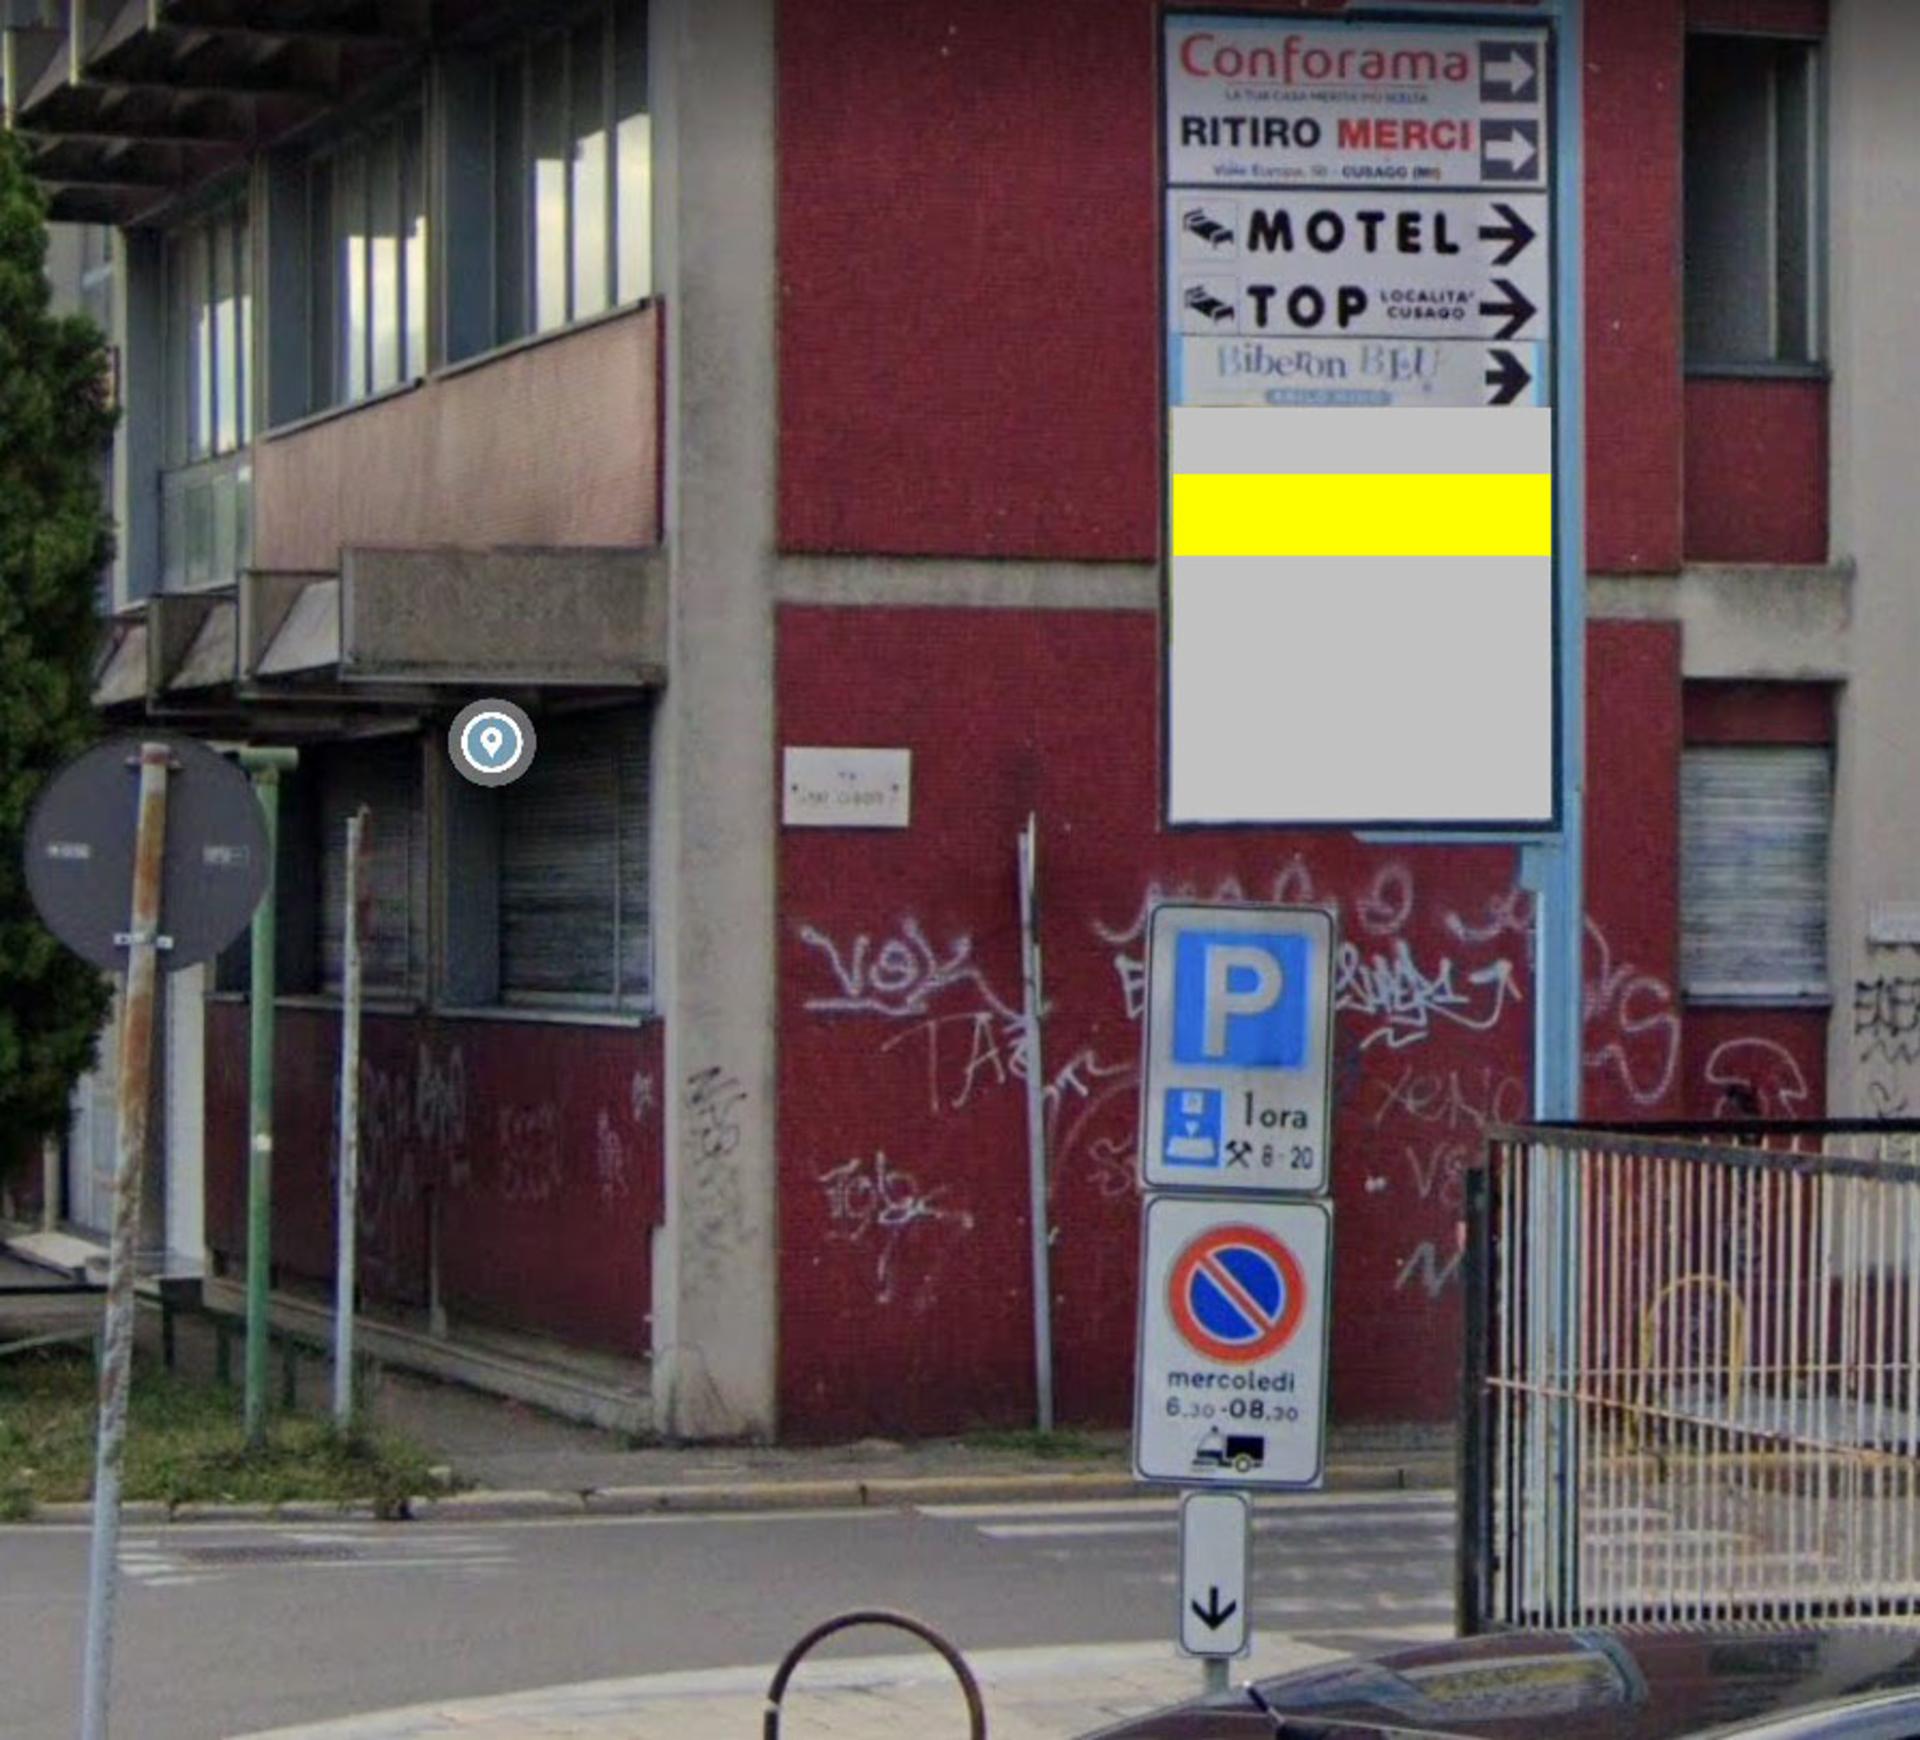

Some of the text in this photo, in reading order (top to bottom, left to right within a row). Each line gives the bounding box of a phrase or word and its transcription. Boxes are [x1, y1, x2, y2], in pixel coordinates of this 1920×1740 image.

[1180, 34, 1469, 84] Conforama
[1180, 115, 1474, 151] RITIRO MERCI
[1246, 209, 1461, 255] MOTEL
[1245, 284, 1369, 328] TOP
[1217, 341, 1346, 378] Biberon
[1205, 943, 1283, 1058] P
[1259, 1107, 1309, 1129] ora
